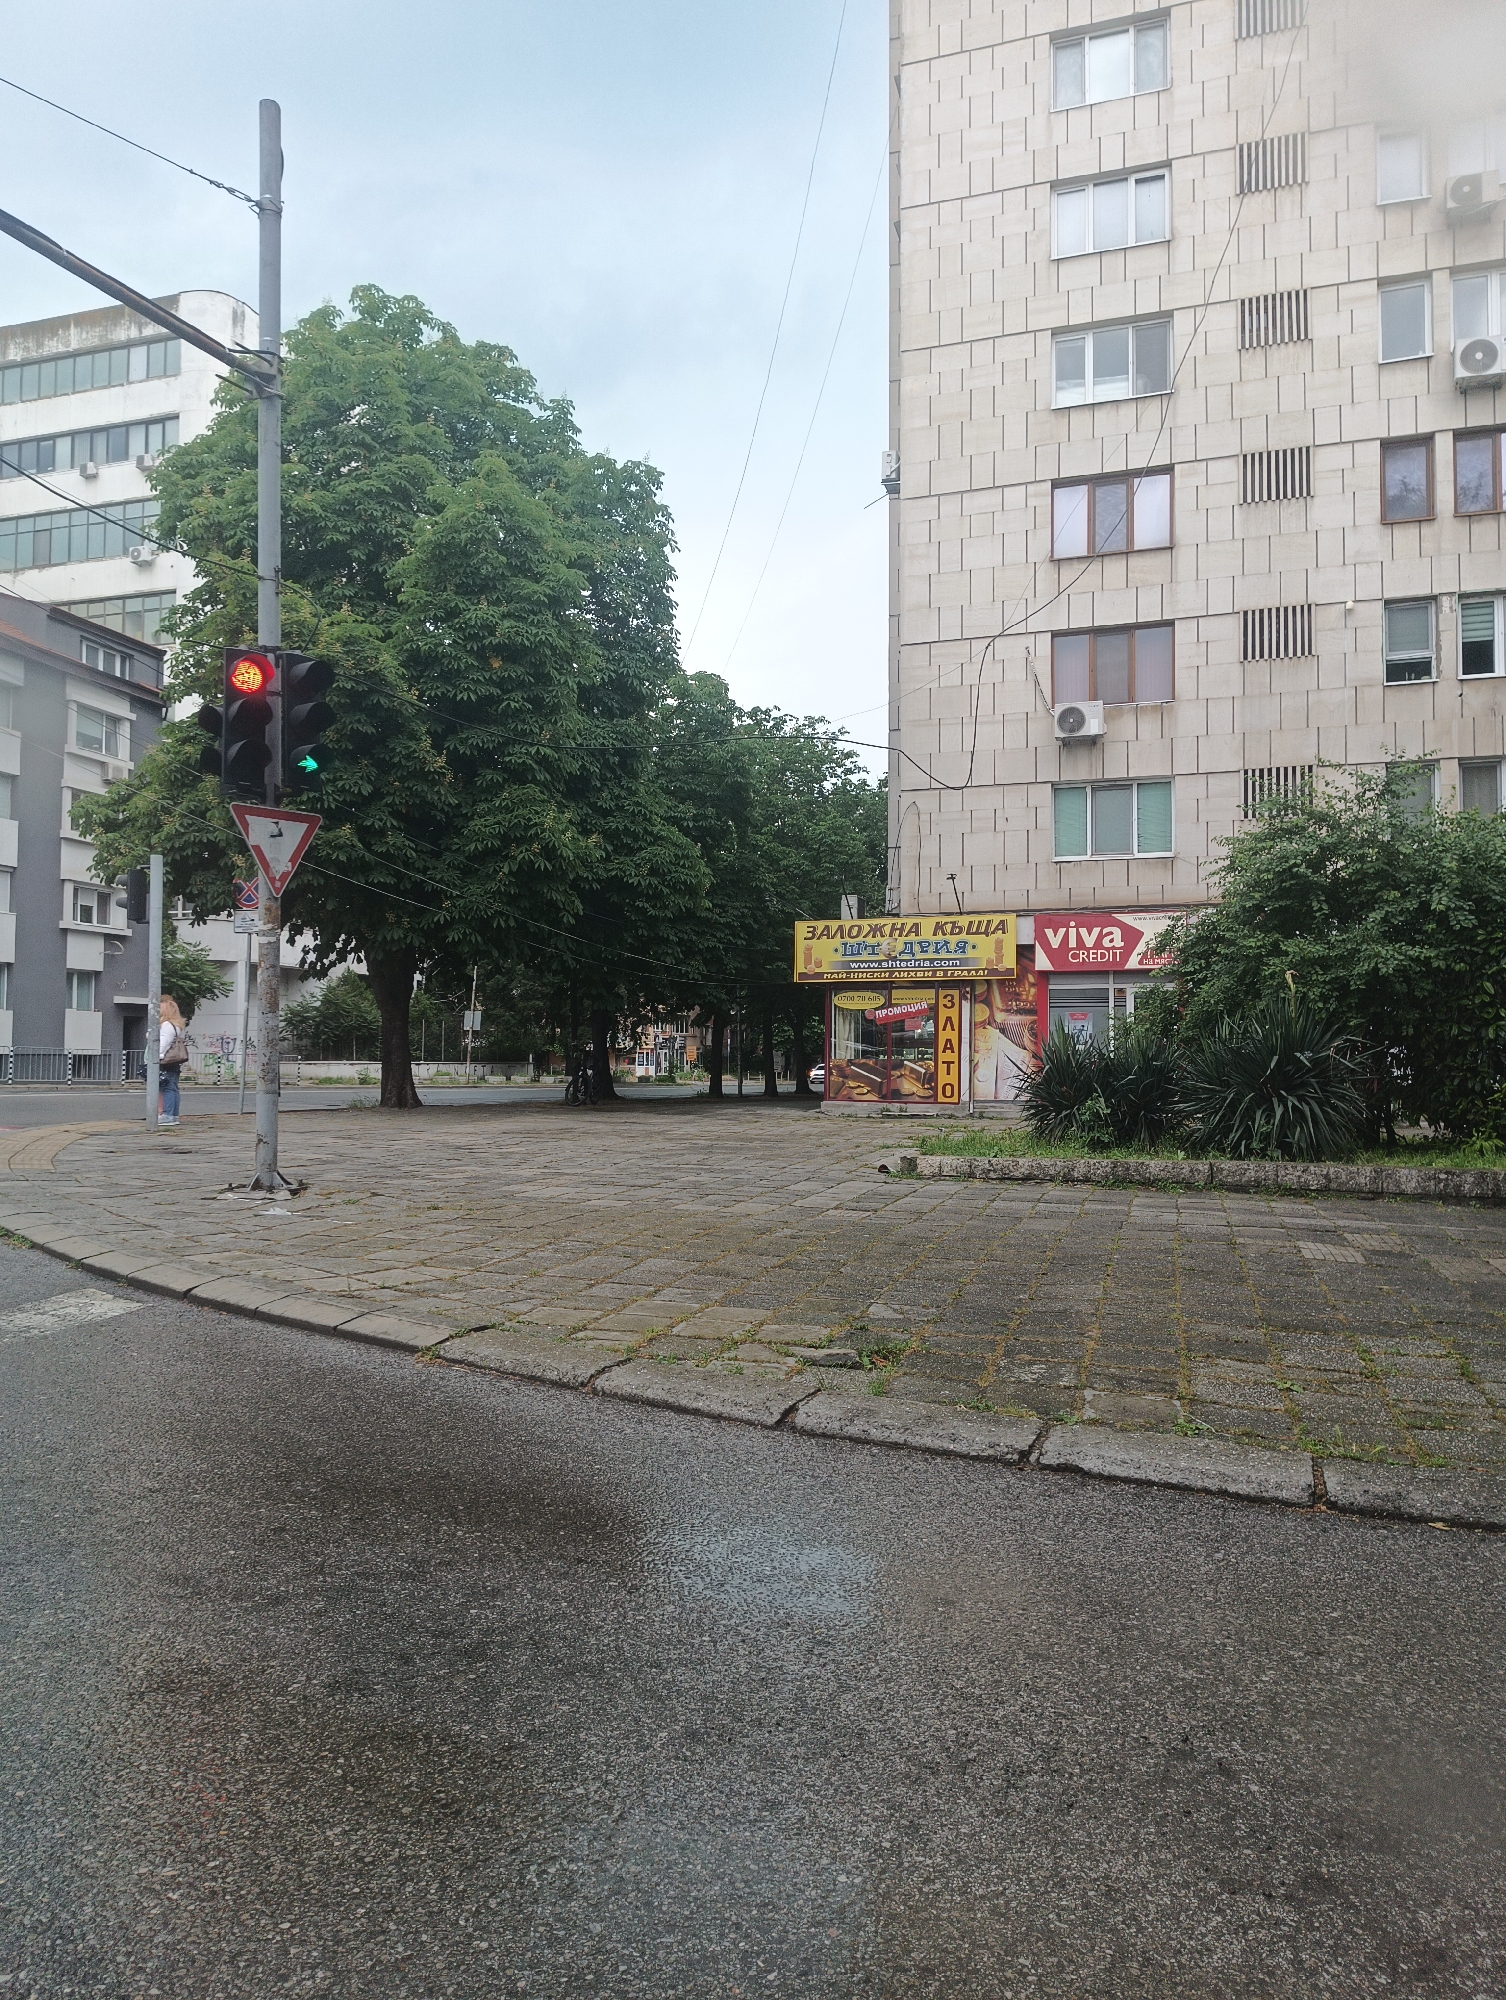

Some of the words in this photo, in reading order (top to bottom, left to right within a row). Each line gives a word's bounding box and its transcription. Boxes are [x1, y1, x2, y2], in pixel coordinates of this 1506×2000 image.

[804, 922, 922, 940] ЗАЛОЖНА
[932, 919, 1009, 937] КЪЩА
[1044, 921, 1124, 948] viva
[849, 959, 960, 969] www.shtedria.com
[1068, 949, 1124, 962] CREDIT
[823, 971, 890, 979] НАЙ-НИСКИ
[892, 970, 933, 978] ЛИХВИ
[875, 1001, 928, 1018] ПРОМОЦИЯ
[942, 994, 956, 1099] ЗЛАТО
